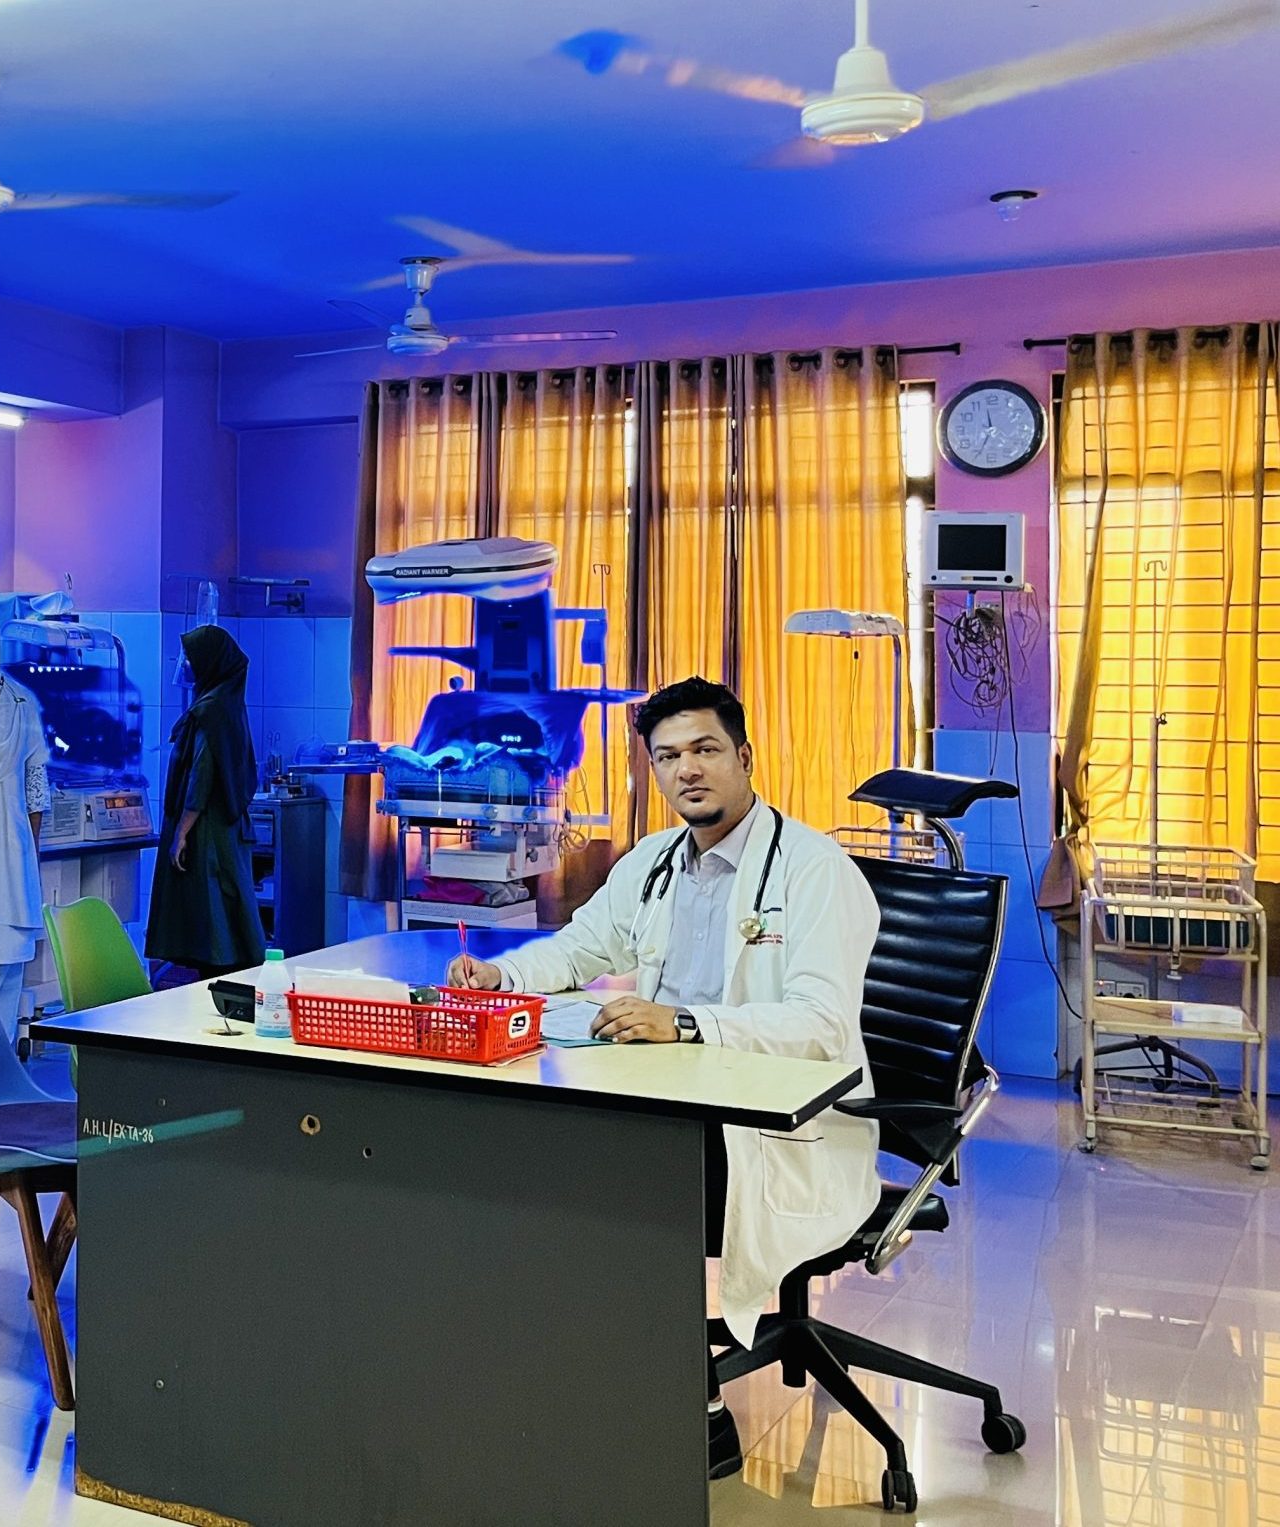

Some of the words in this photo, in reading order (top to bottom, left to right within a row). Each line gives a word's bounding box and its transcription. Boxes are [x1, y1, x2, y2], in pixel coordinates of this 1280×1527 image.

[985, 395, 998, 406] 12
[971, 401, 980, 412] 11
[960, 412, 973, 422] 10
